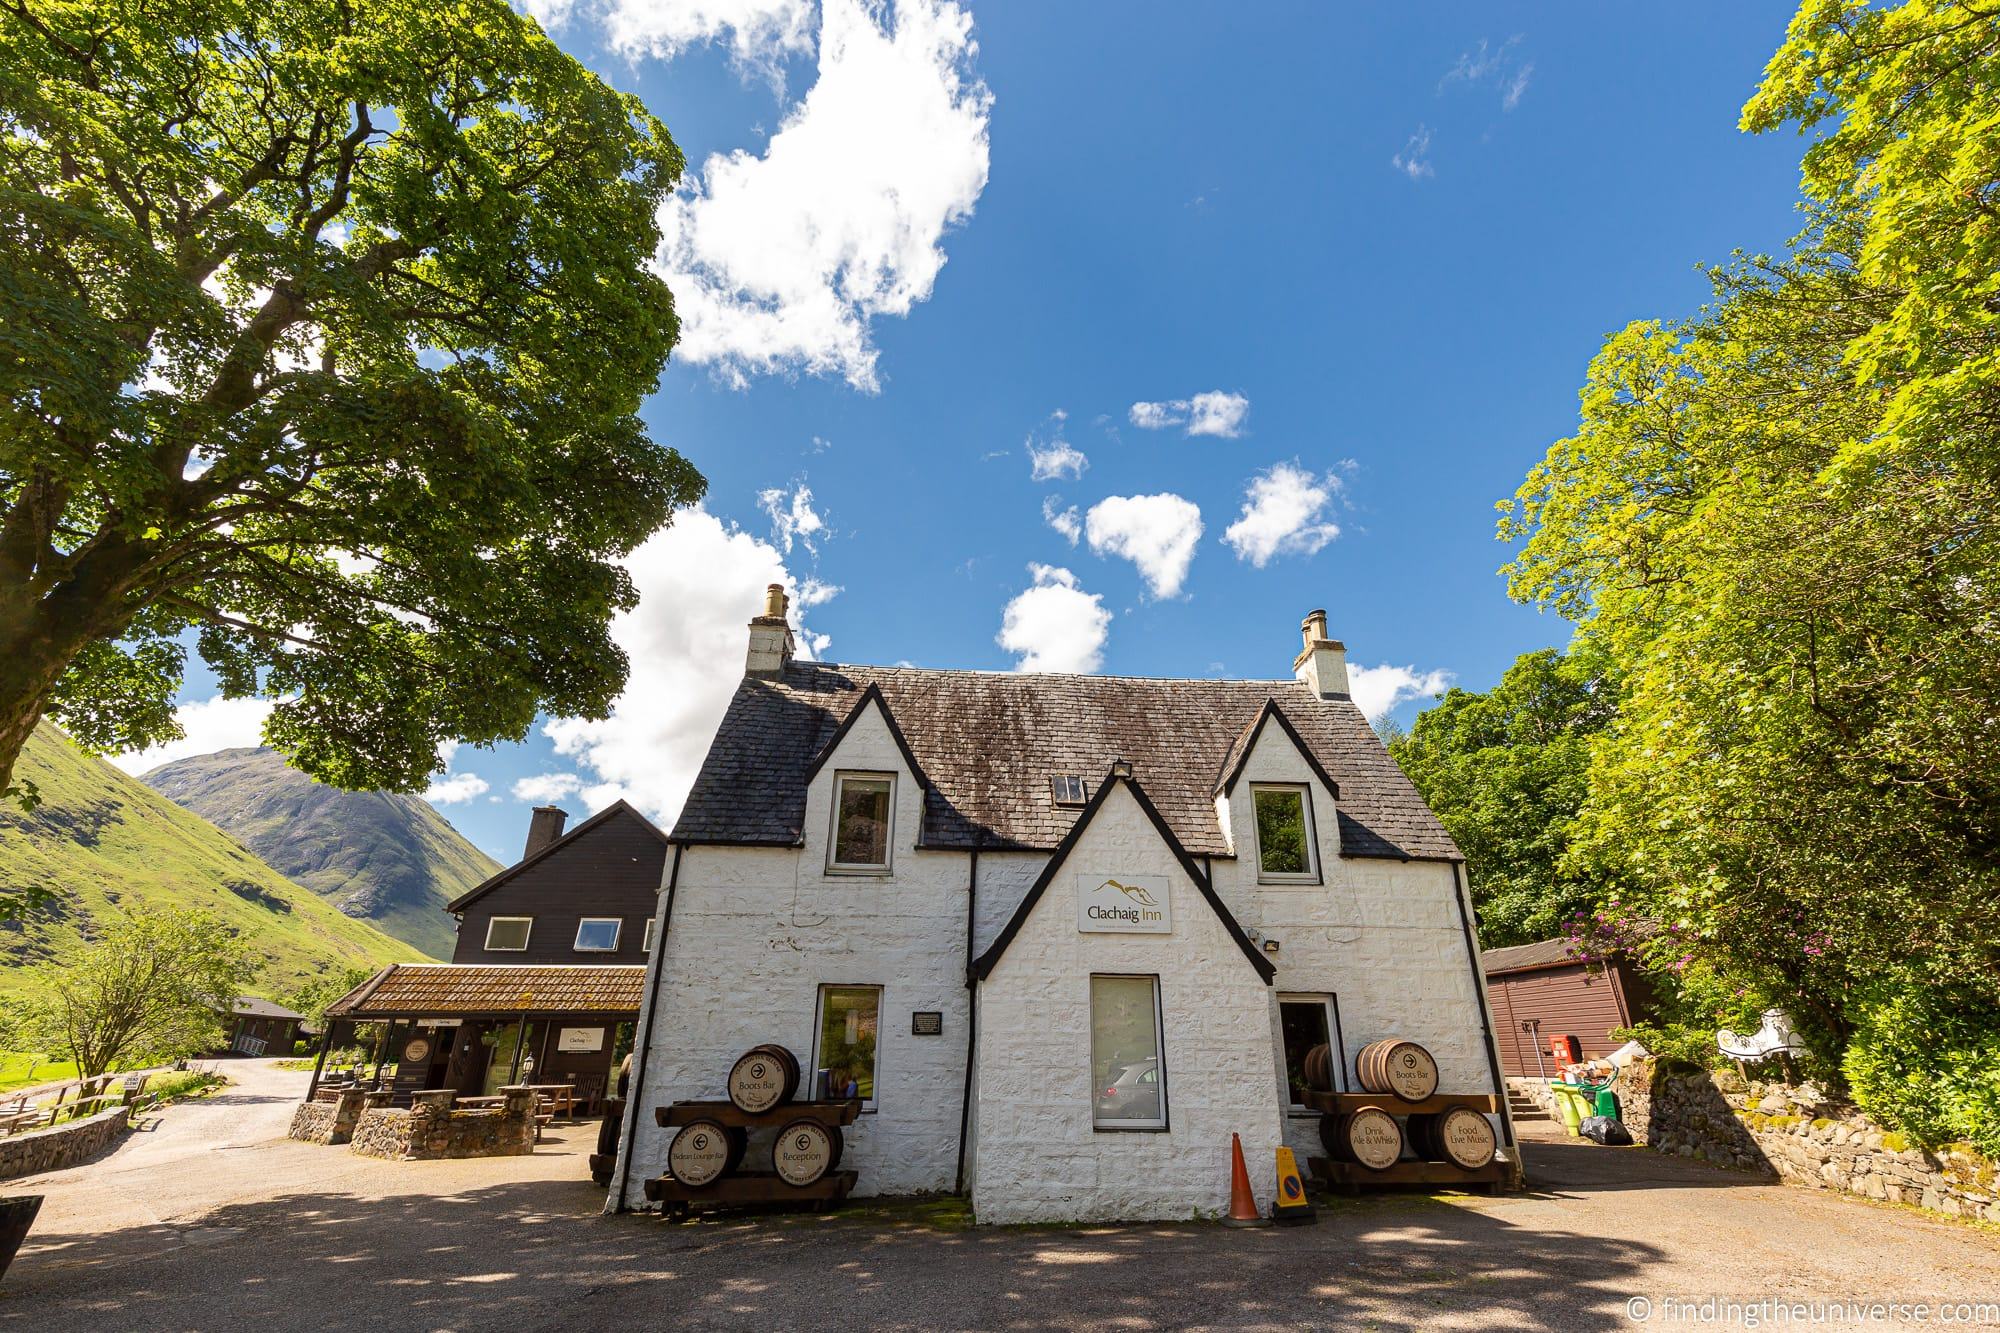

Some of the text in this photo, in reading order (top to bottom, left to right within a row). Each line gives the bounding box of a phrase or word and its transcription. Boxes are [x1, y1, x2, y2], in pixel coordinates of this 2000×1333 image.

[1087, 905, 1162, 924] Clachaig Inn
[1396, 1070, 1429, 1079] Boots Bar
[739, 1080, 776, 1090] Boots Bar
[1458, 1125, 1477, 1135] Food
[1353, 1135, 1399, 1146] Ale & Whisky
[1450, 1135, 1489, 1144] Live Music
[783, 1152, 822, 1163] Reception
